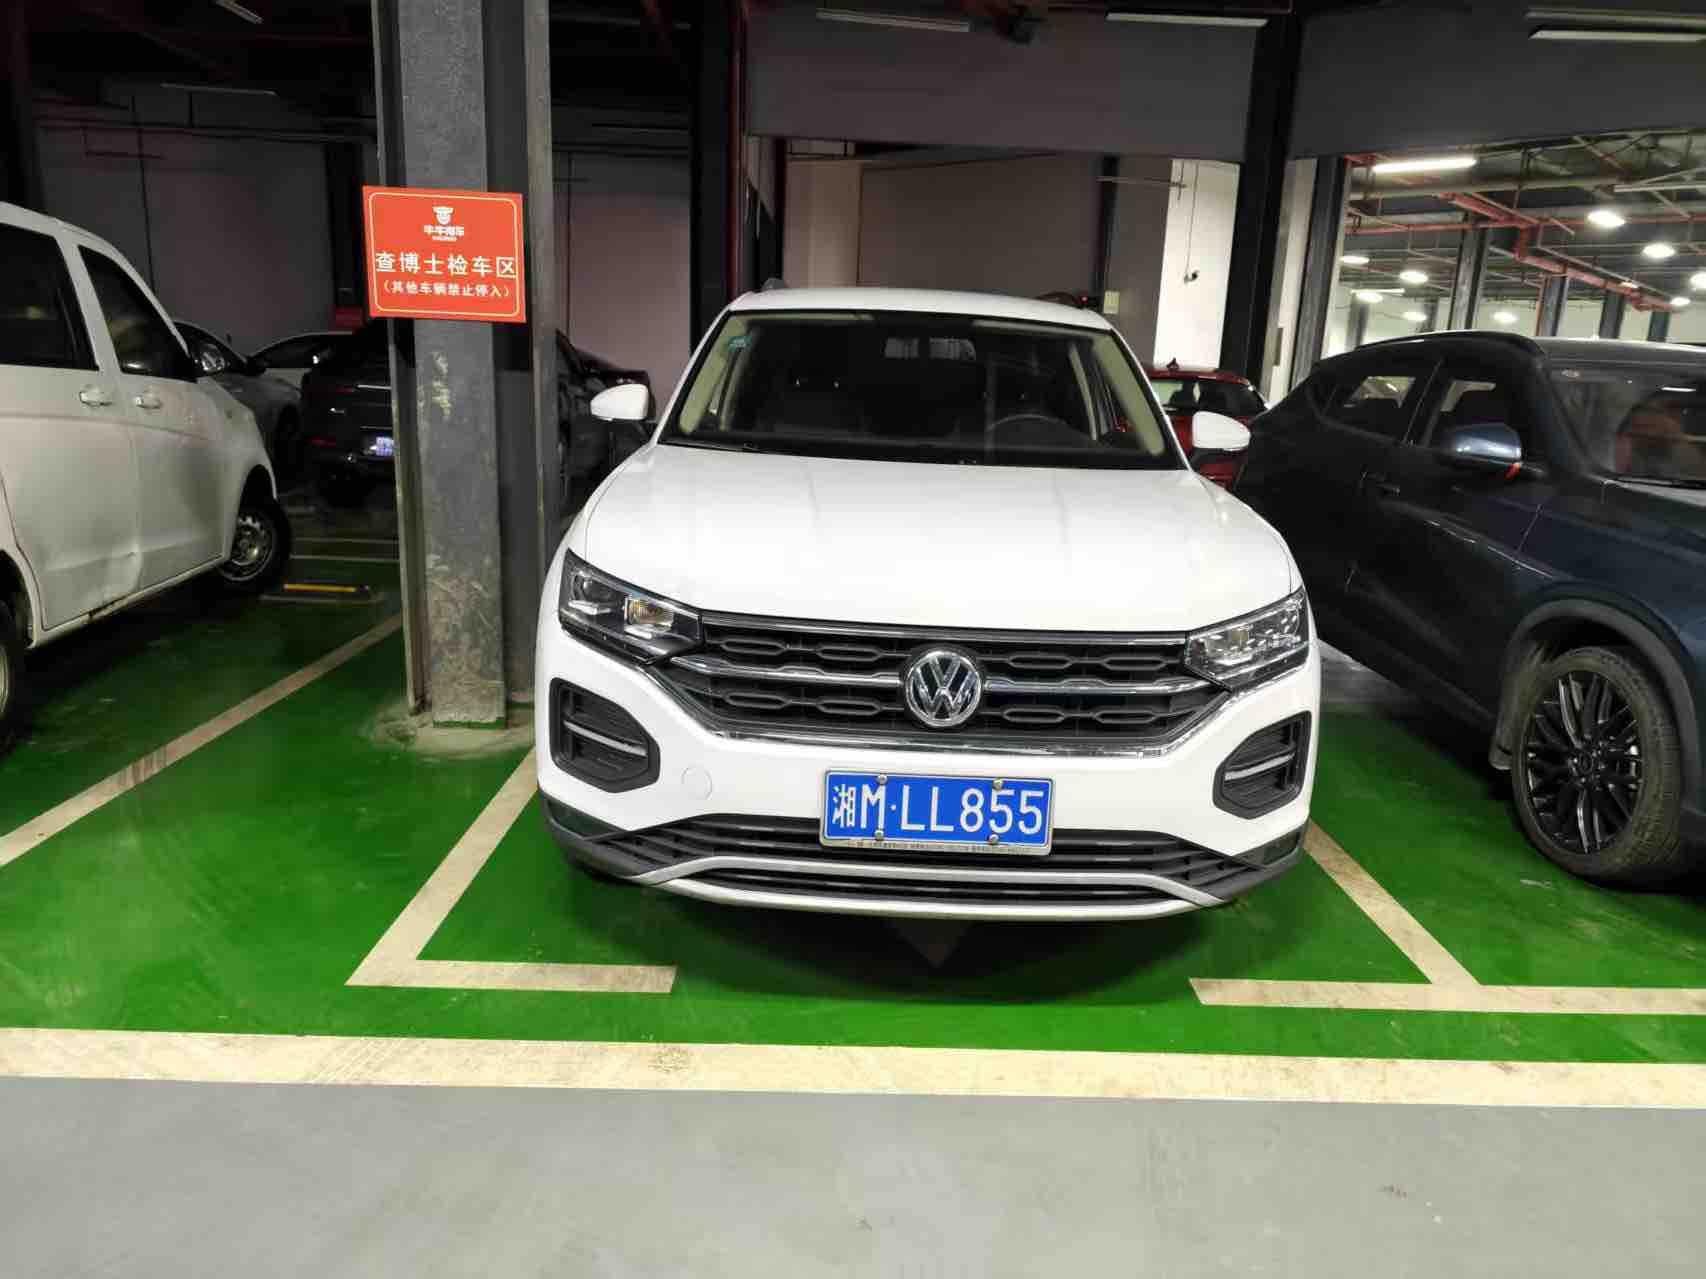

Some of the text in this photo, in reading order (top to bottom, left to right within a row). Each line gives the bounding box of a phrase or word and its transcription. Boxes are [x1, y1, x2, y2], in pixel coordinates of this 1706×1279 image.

[375, 251, 517, 279] 查博士检车区
